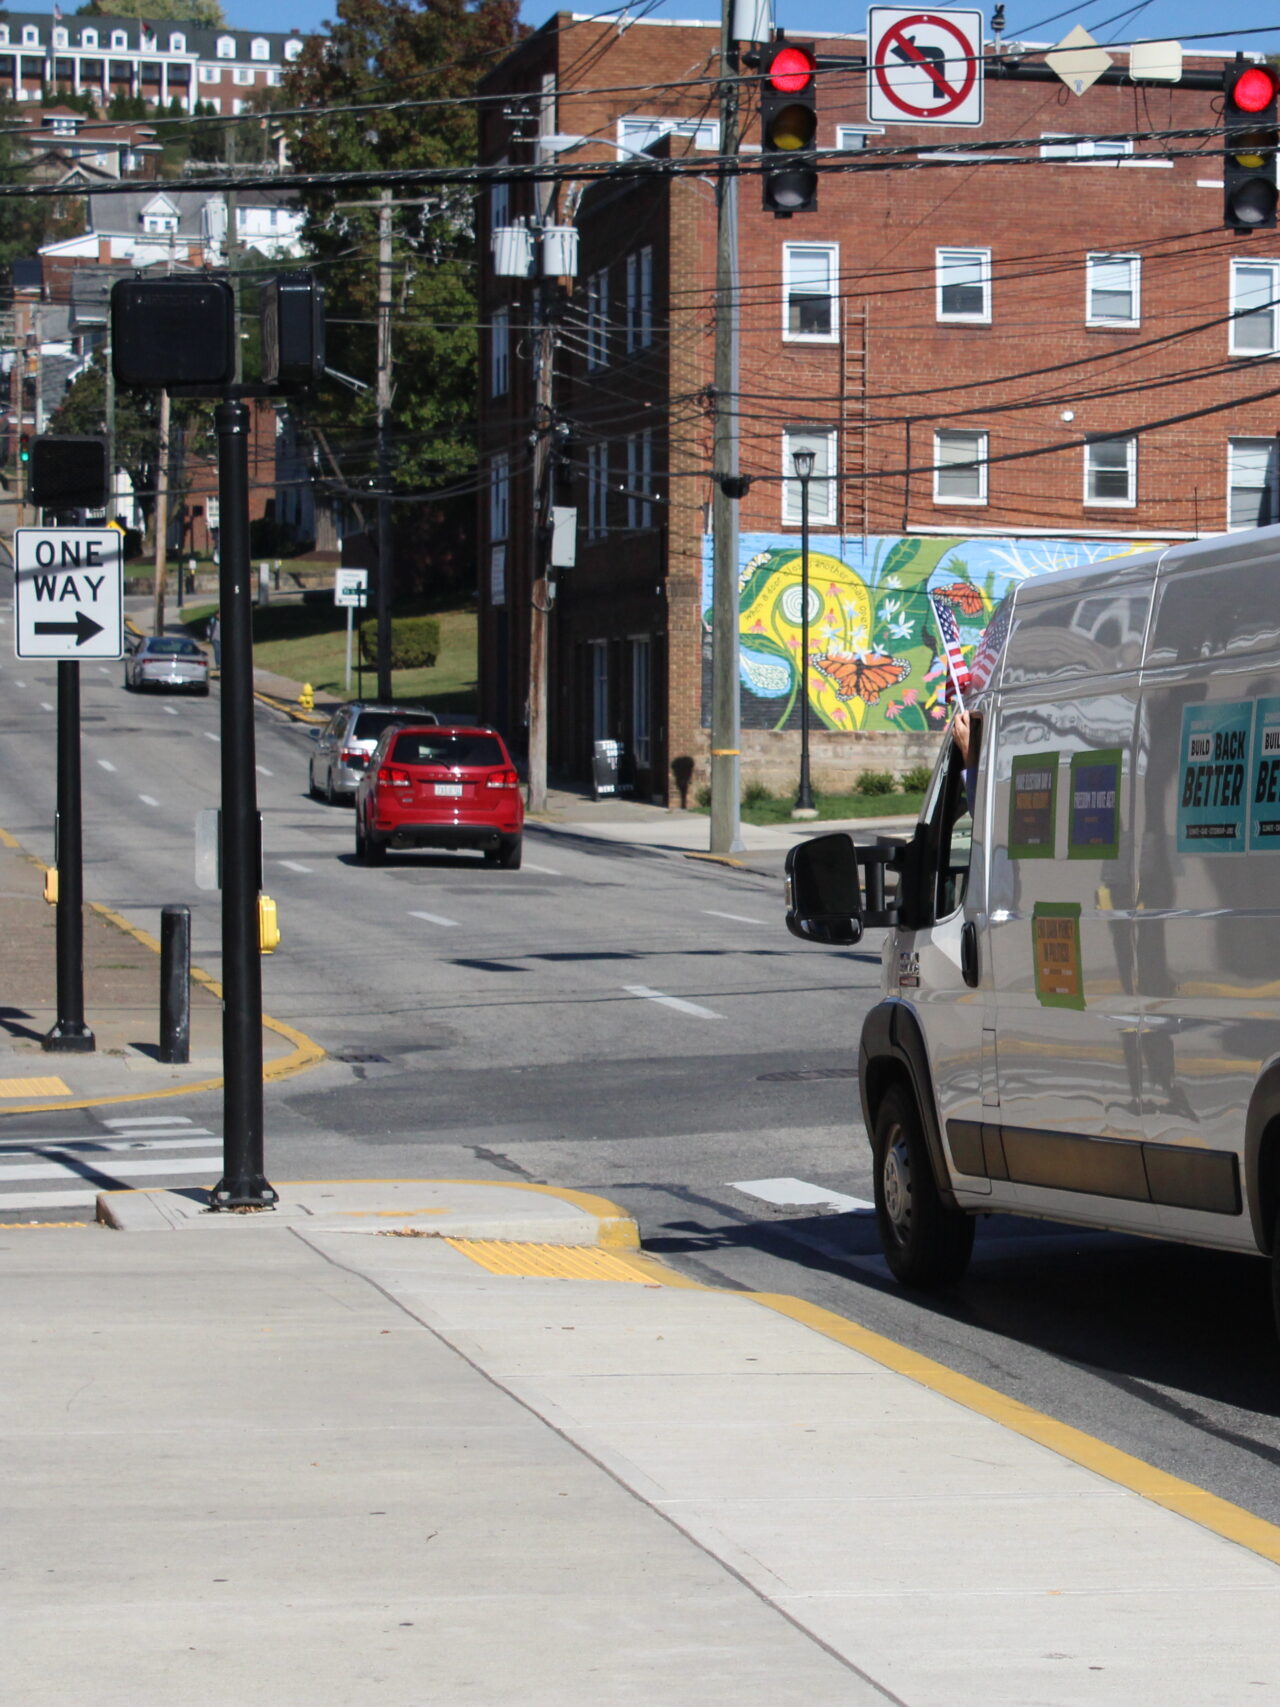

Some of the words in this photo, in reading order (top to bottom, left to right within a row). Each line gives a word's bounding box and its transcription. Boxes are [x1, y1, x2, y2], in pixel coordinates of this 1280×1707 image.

[36, 540, 103, 567] ONE
[33, 575, 105, 602] WAY
[1191, 739, 1211, 757] BUILD
[1215, 731, 1246, 761] BACK
[1182, 764, 1244, 808] BETTER
